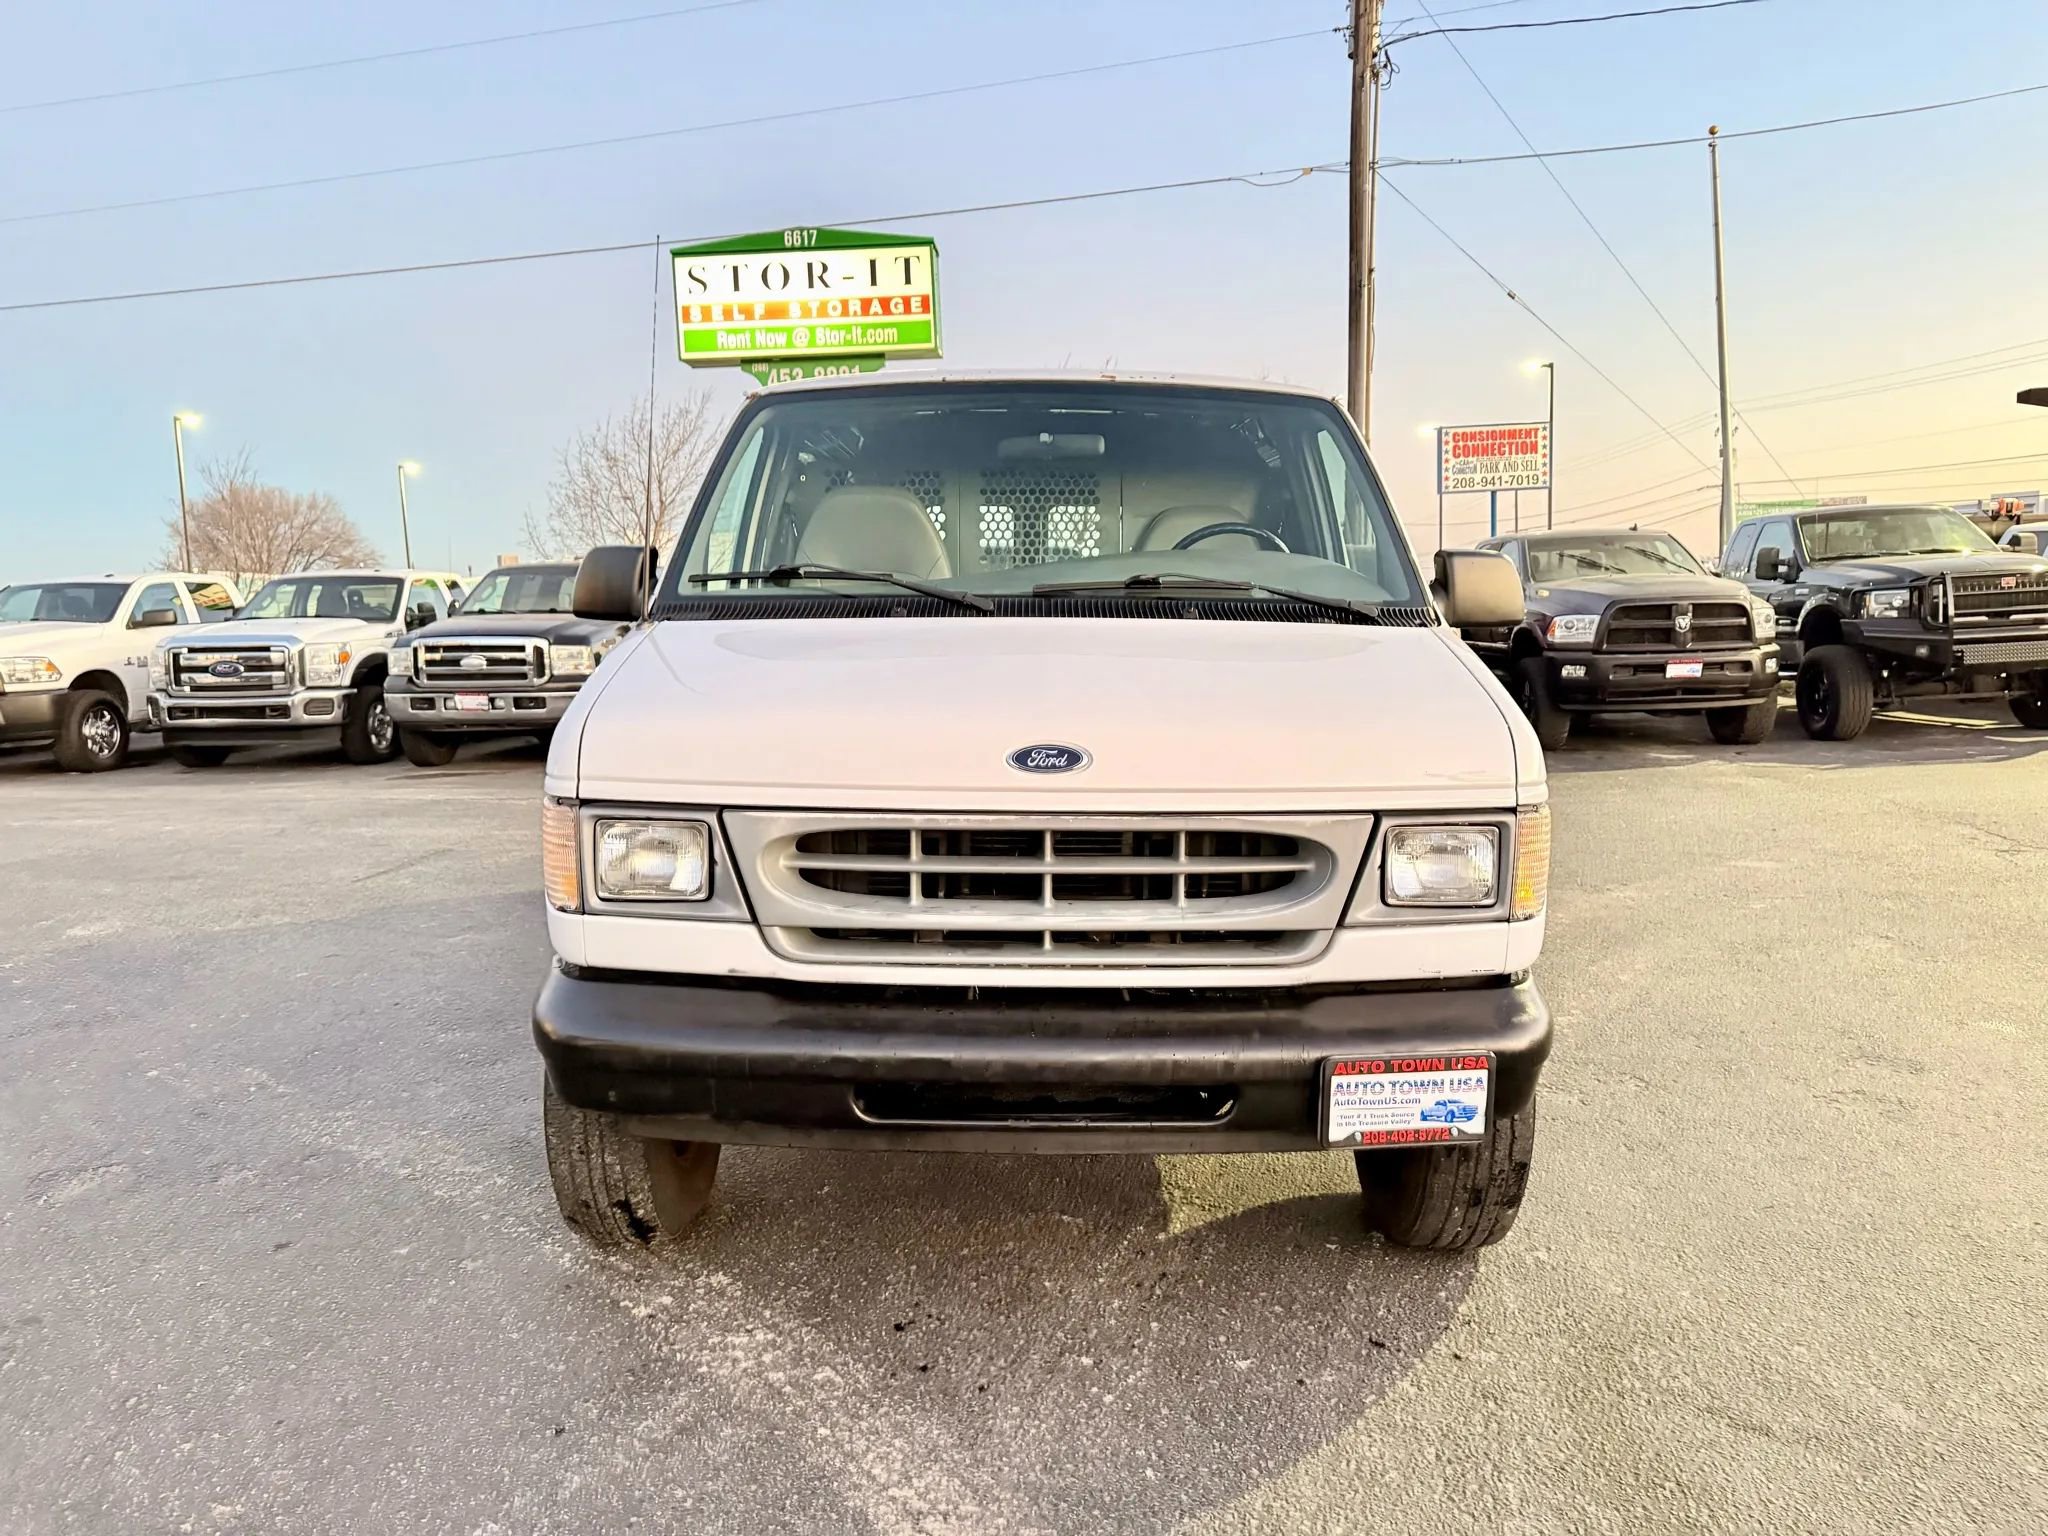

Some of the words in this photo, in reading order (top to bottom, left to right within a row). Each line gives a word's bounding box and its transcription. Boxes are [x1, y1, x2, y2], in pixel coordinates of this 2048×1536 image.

[784, 229, 817, 247] 6617
[687, 255, 921, 295] STOR-IT
[689, 302, 766, 323] SELF
[788, 295, 923, 318] STORAGE
[716, 329, 751, 350] Rent
[756, 329, 787, 348] Now
[792, 326, 810, 348] @
[815, 325, 898, 346] Stor-It.com
[1452, 428, 1540, 443] CONSIGNMENT
[1452, 439, 1539, 459] CONNECTION
[1480, 461, 1500, 474] PARK
[1502, 461, 1519, 473] AND
[1521, 459, 1540, 472] SELL
[1452, 474, 1540, 489] 208-941-7019
[1027, 748, 1068, 767] Ford
[1333, 1060, 1386, 1075] AUTO
[1390, 1058, 1445, 1072] TOWN
[1451, 1056, 1489, 1070] USA
[1332, 1080, 1385, 1097] AUTO
[1388, 1078, 1445, 1096] TOWN
[1450, 1076, 1486, 1093] USA
[1334, 1096, 1421, 1107] AutoTownUS.com
